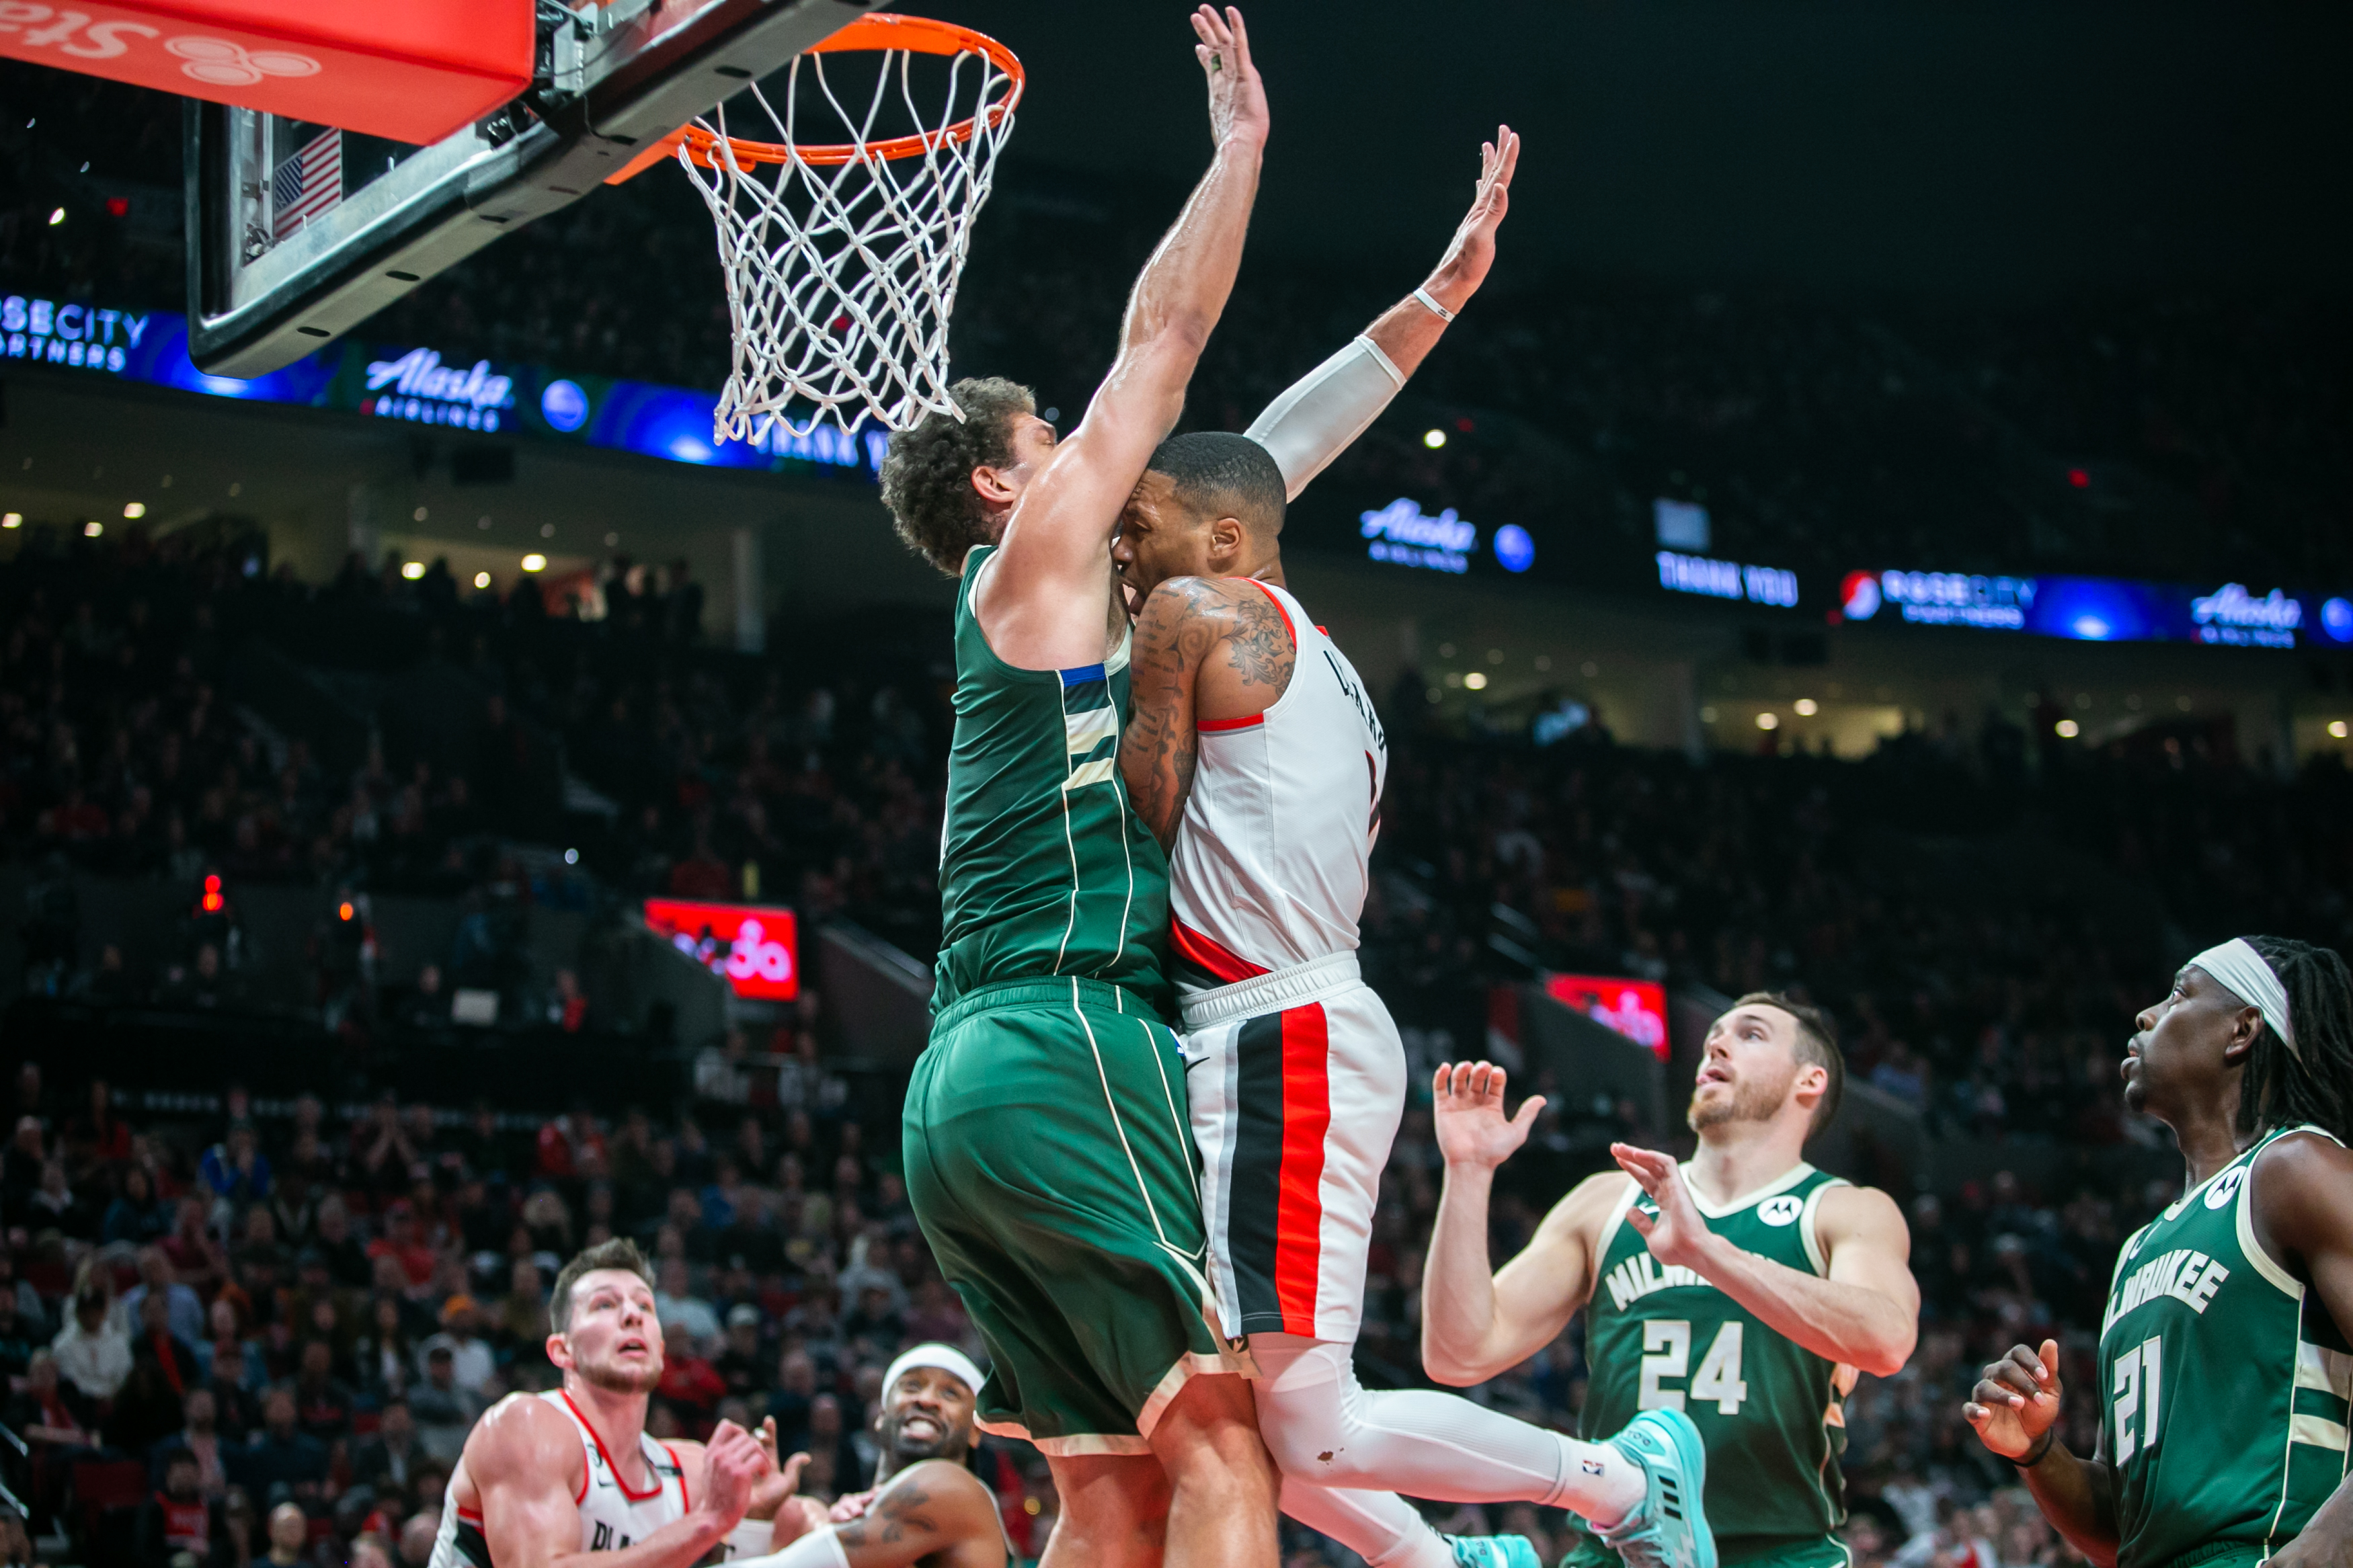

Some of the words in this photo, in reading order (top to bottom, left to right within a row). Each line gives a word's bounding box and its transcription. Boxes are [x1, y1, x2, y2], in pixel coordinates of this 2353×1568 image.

[365, 347, 513, 411] Alaska
[1359, 497, 1476, 552] Alaska
[1655, 550, 1744, 600] THANK
[1743, 563, 1799, 608] YOU
[1638, 1319, 1747, 1415] 24
[2114, 1335, 2161, 1467] 21
